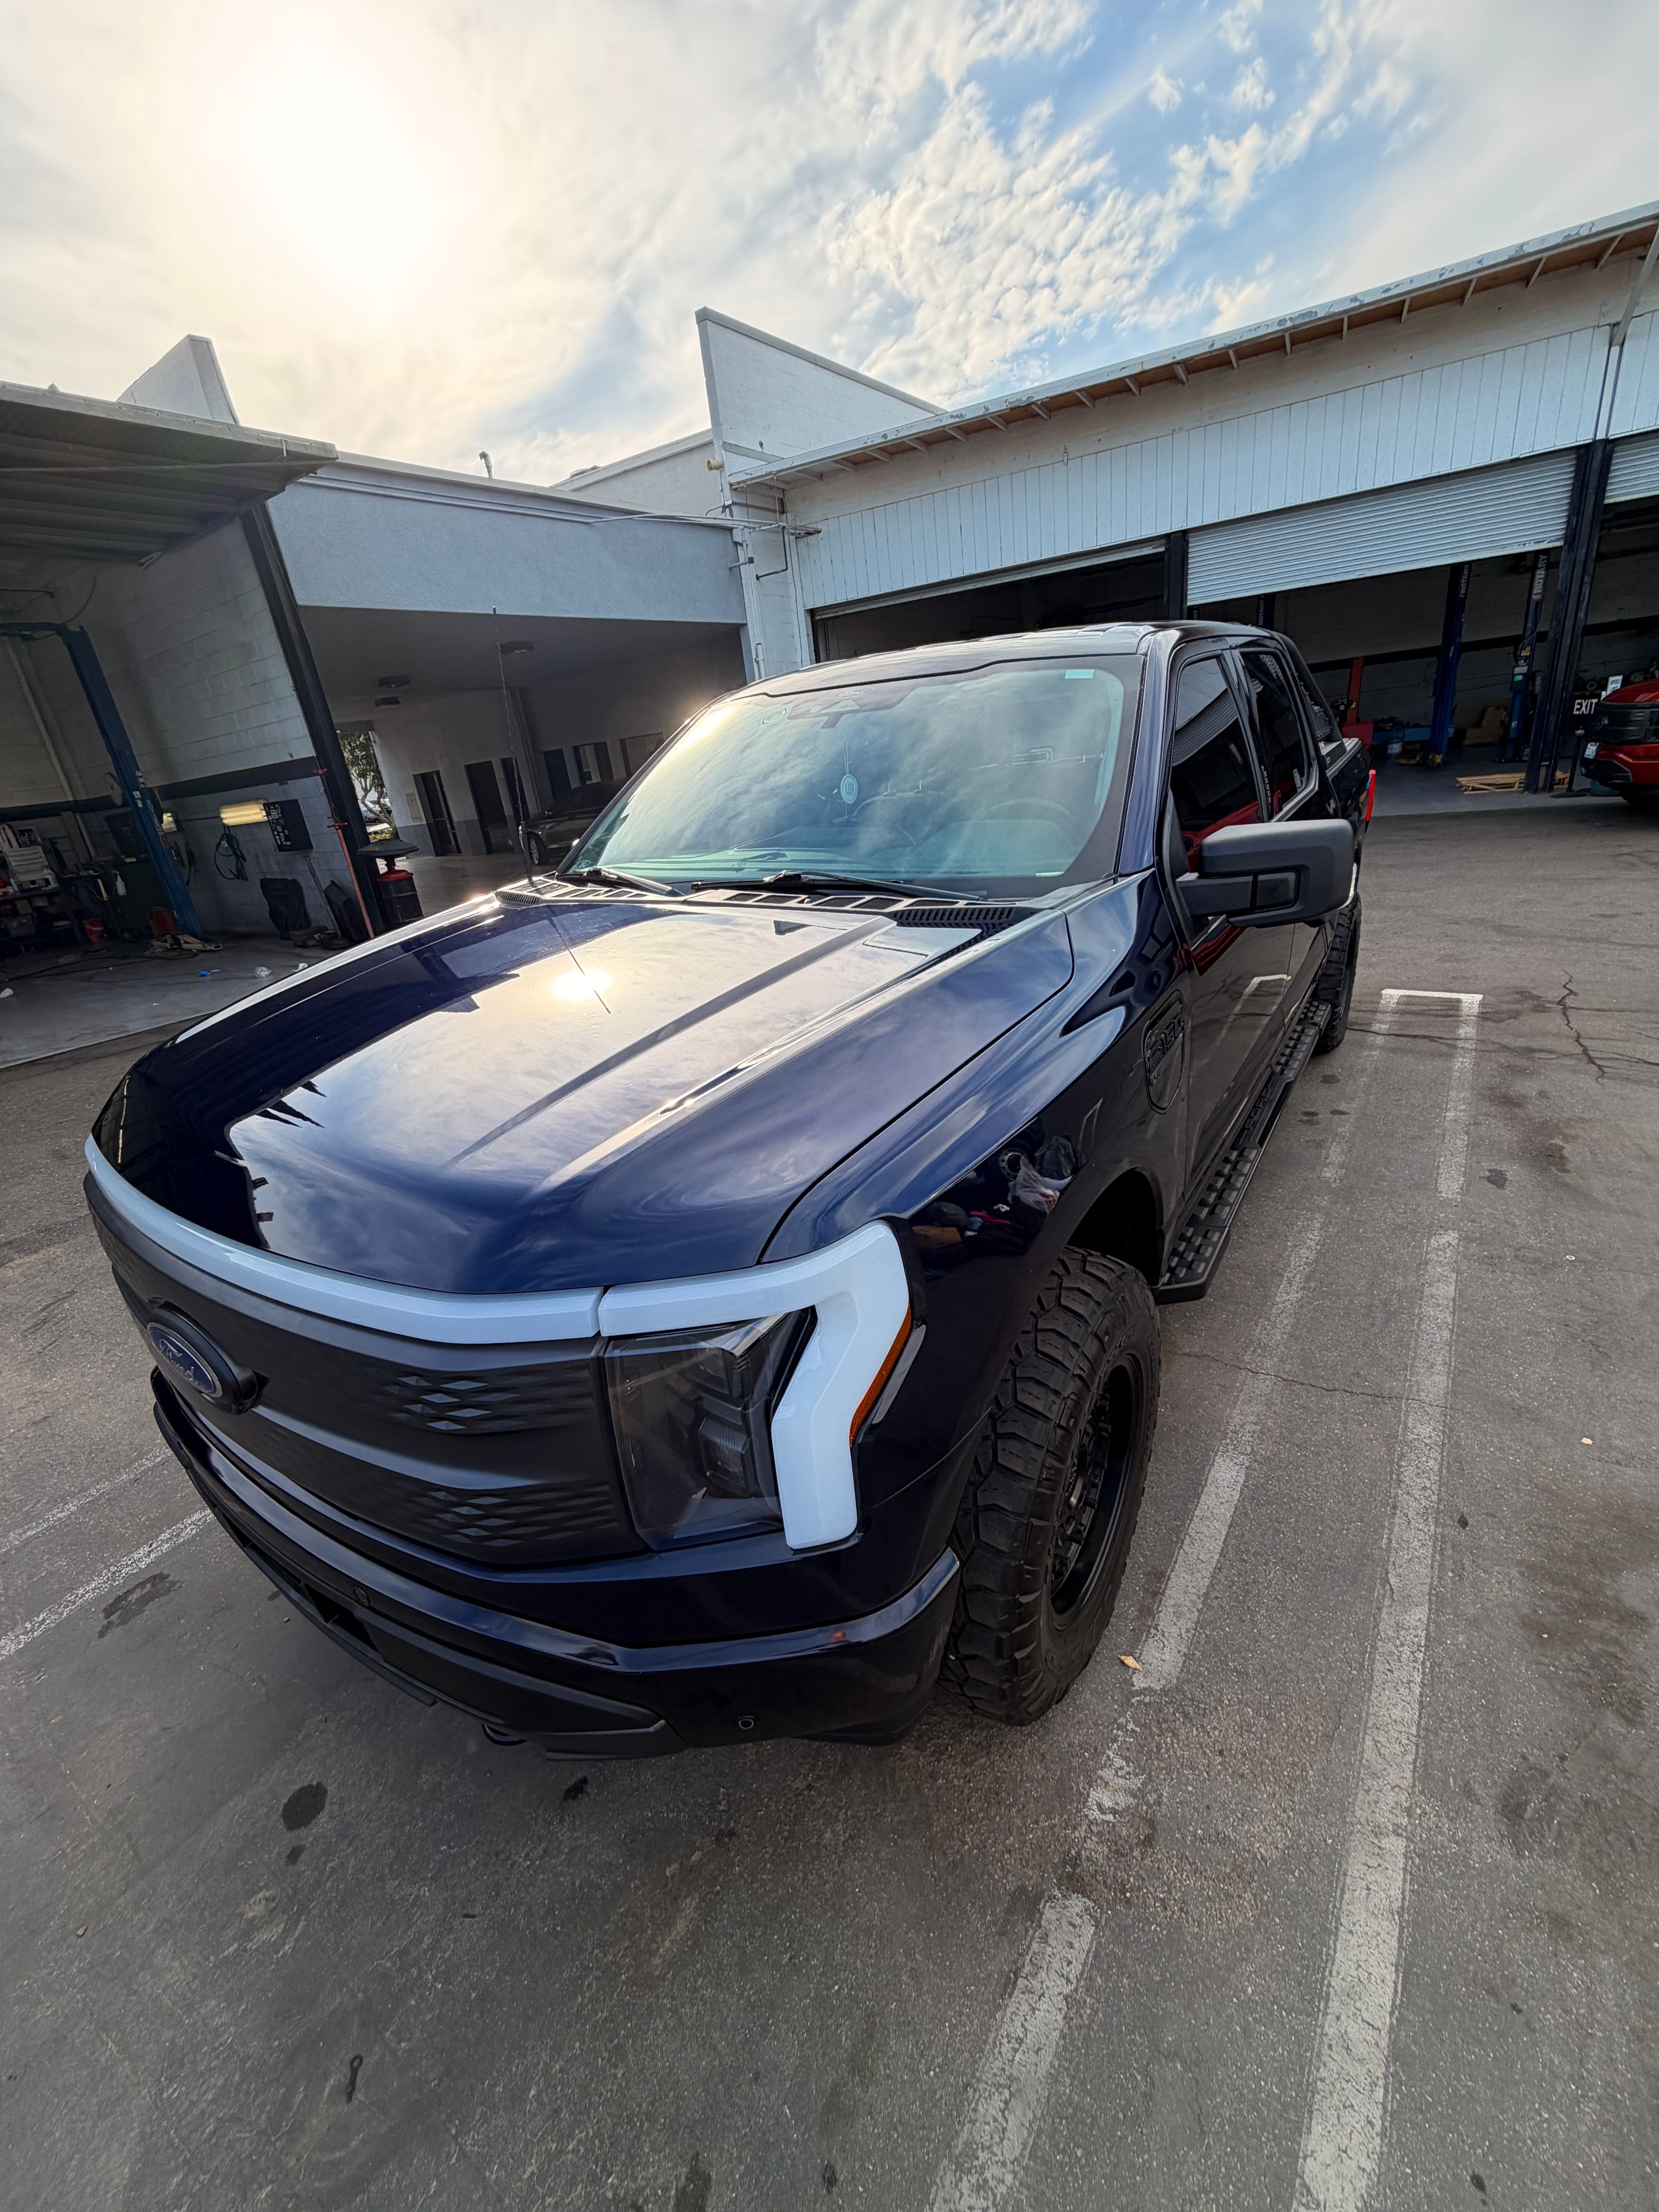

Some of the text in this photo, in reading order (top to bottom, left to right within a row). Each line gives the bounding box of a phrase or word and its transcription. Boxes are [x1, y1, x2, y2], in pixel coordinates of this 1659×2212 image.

[1534, 555, 1548, 594] ROTARY
[1573, 699, 1598, 714] EXIT
[159, 1339, 199, 1385] Ford
